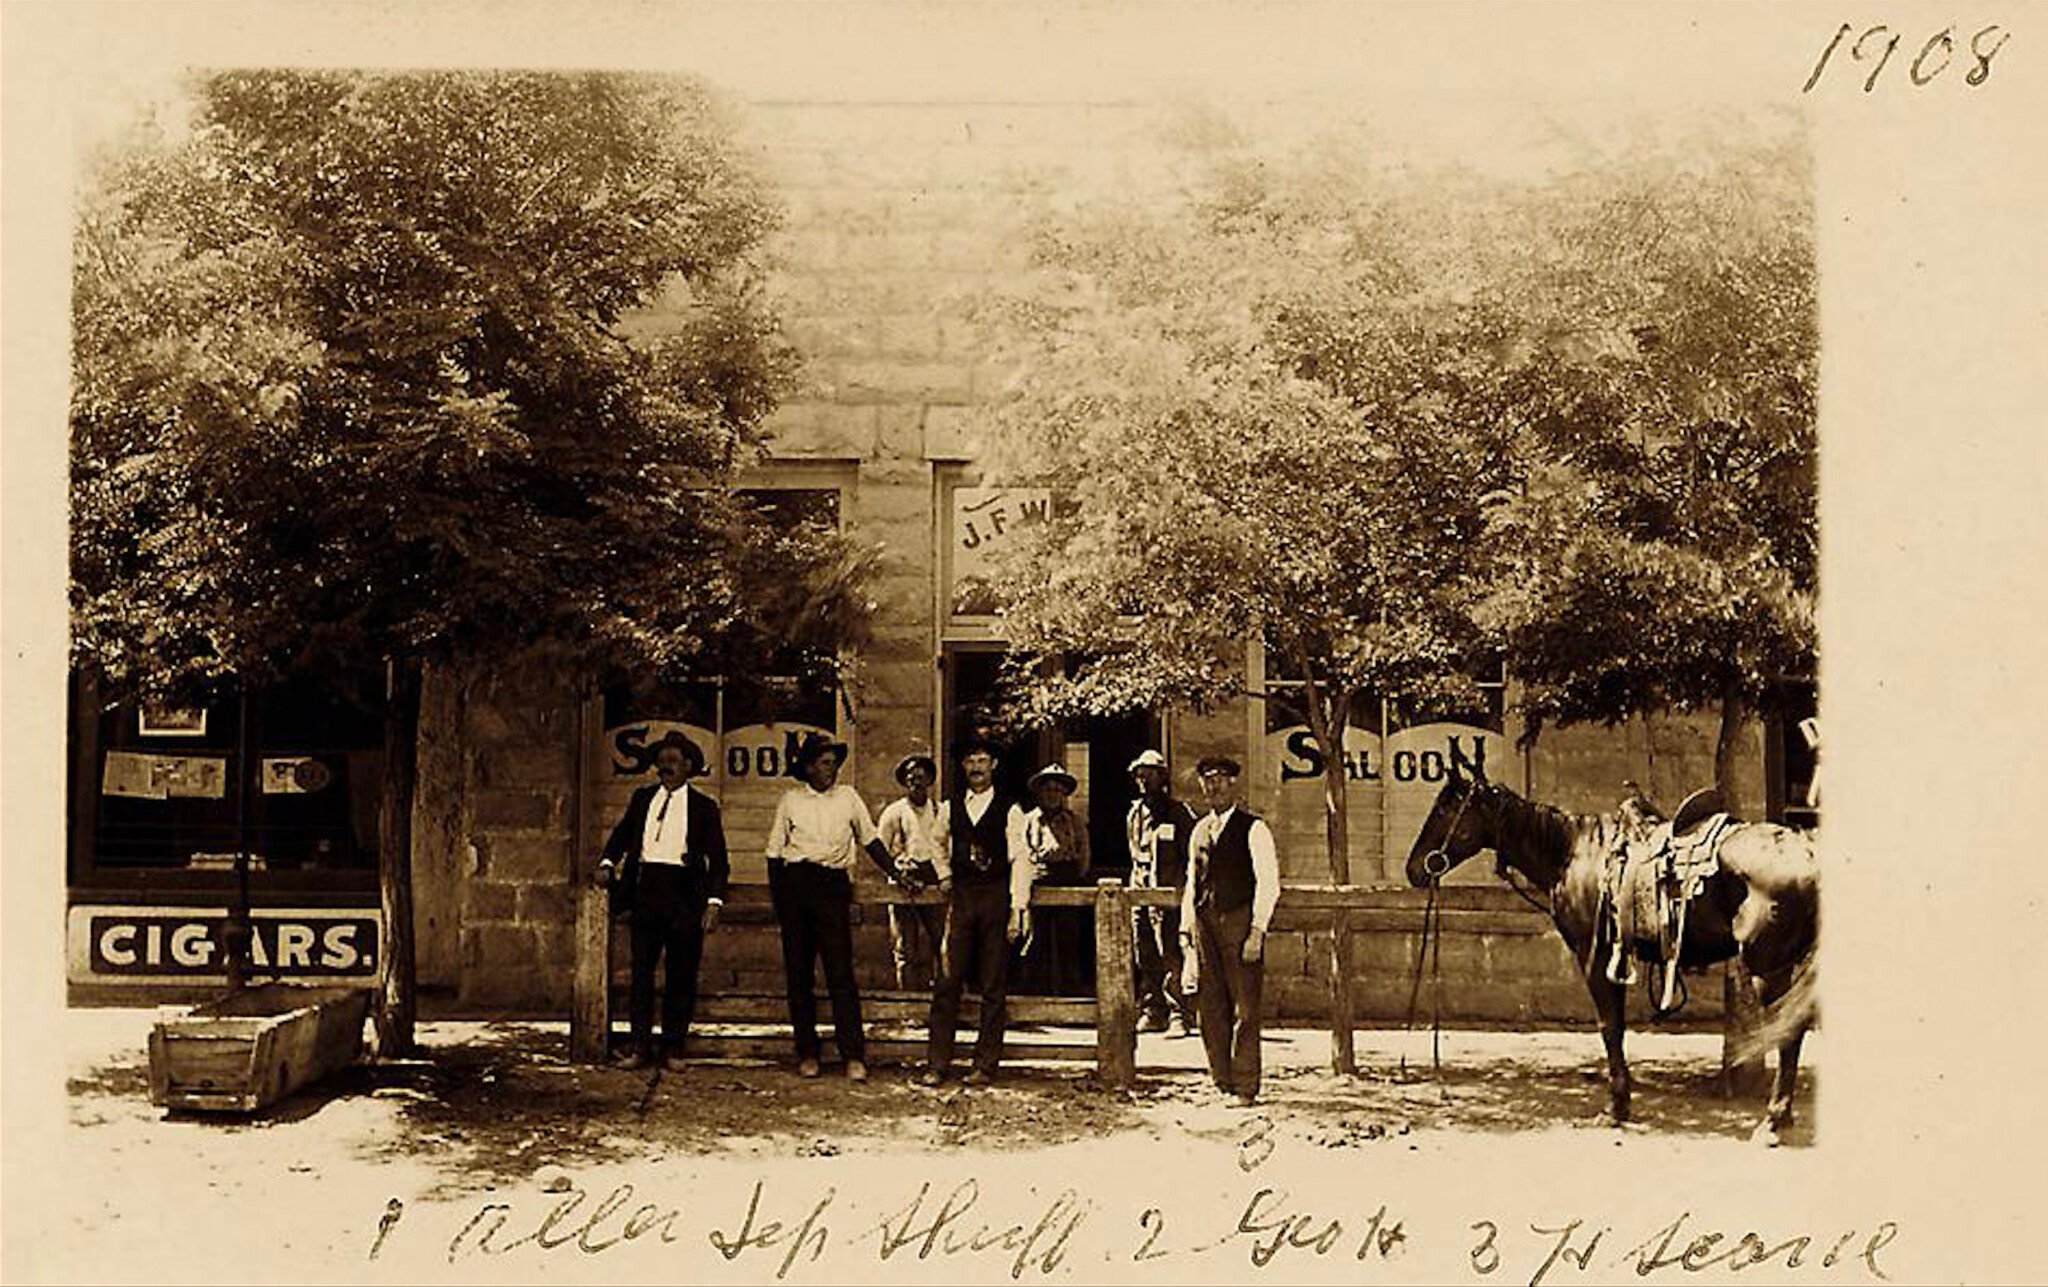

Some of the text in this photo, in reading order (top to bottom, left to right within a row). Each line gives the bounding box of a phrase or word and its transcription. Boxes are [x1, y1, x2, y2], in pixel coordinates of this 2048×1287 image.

[1802, 22, 2011, 93] 1908
[1132, 1207, 1172, 1261] 2
[1469, 1221, 1501, 1275] 3
